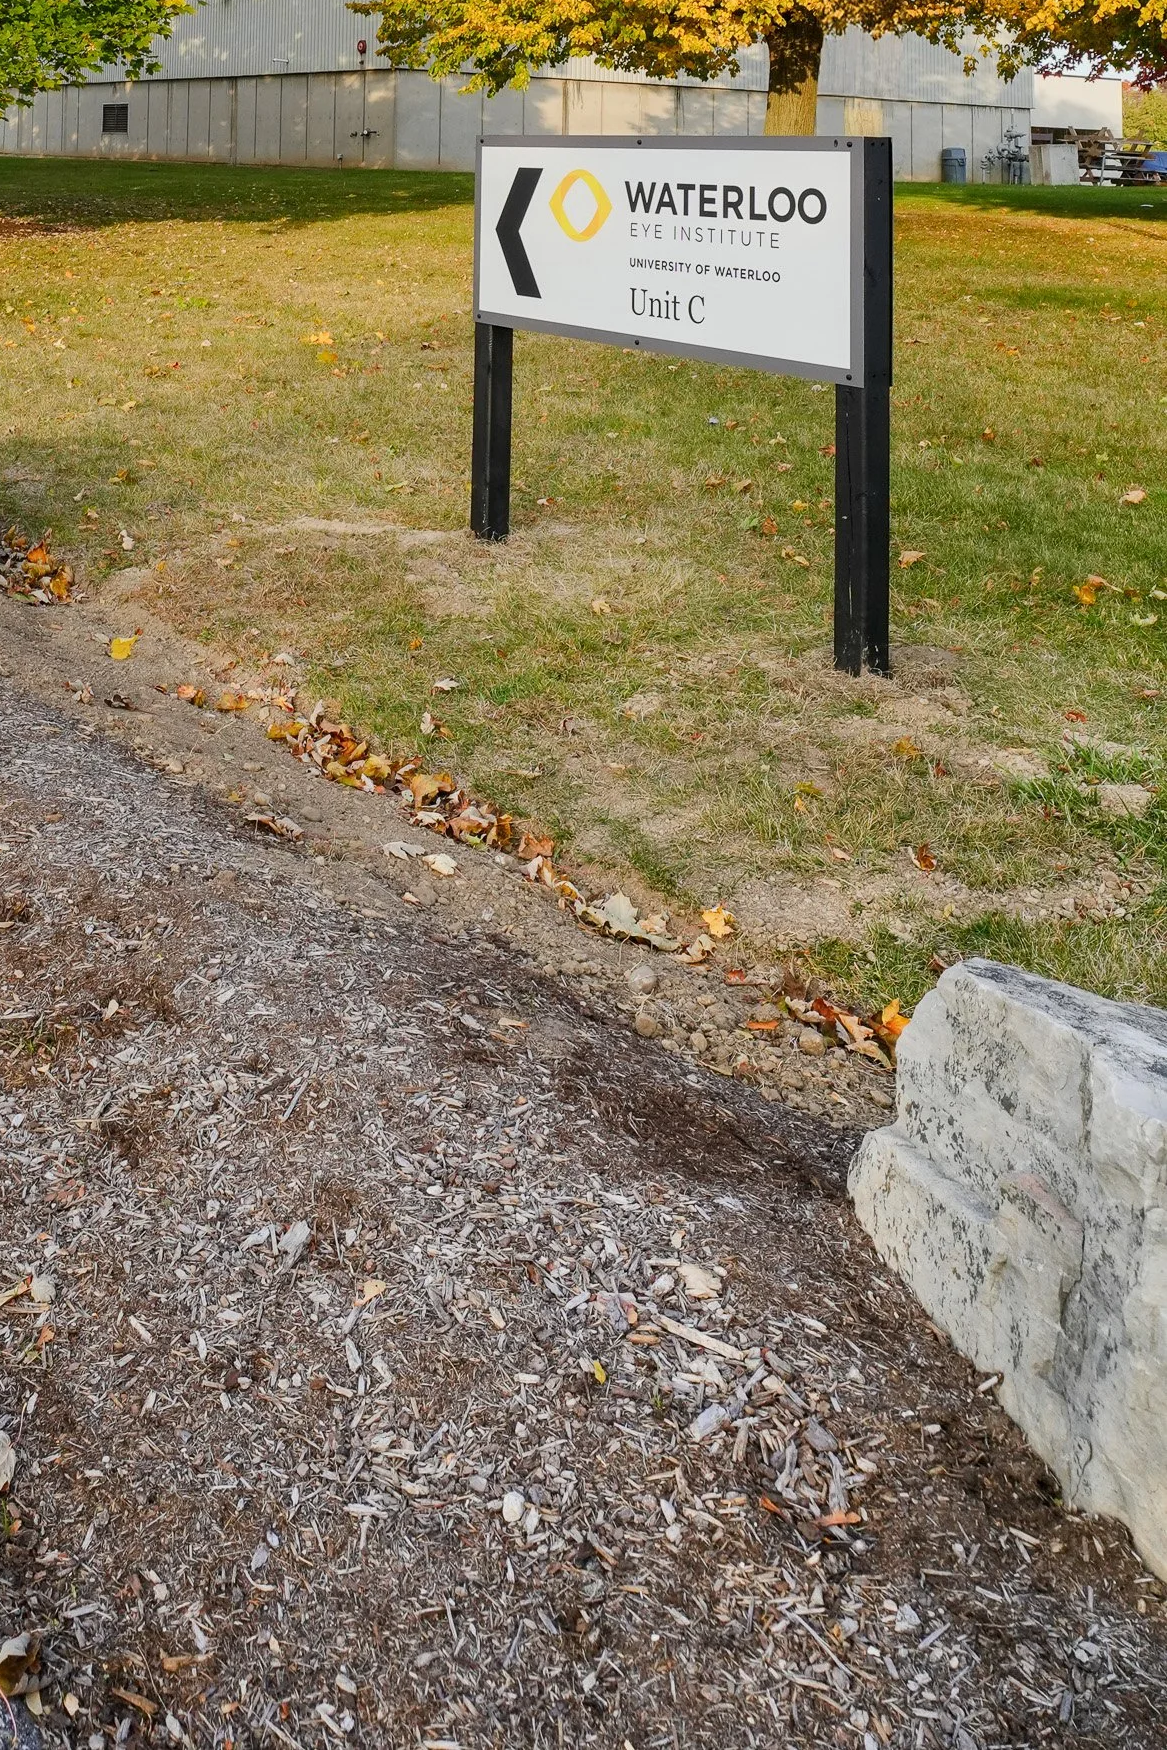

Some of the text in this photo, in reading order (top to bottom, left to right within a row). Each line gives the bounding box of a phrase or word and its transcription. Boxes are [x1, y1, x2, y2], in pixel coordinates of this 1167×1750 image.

[624, 180, 828, 225] WATERLOO
[630, 222, 780, 249] EYE INSTITUTE
[629, 257, 781, 283] UNIVERSITY OF WATERLOO
[629, 287, 706, 325] Unit C
